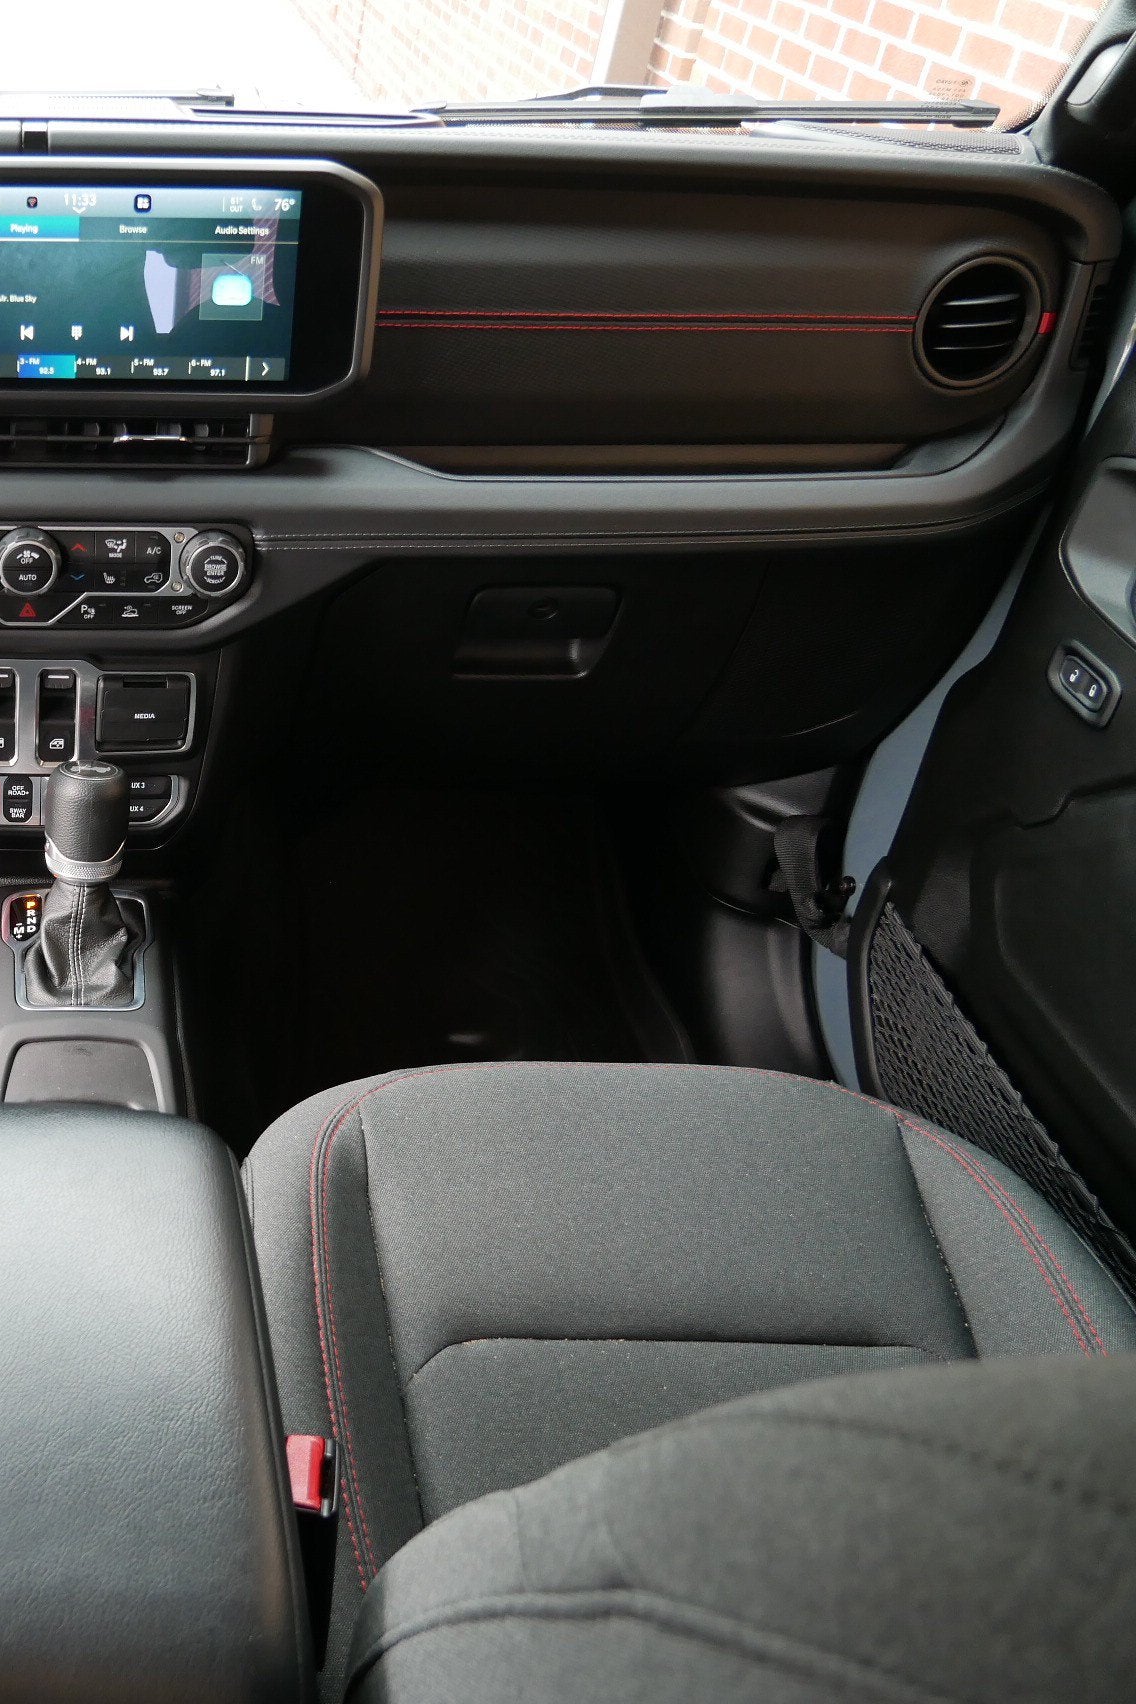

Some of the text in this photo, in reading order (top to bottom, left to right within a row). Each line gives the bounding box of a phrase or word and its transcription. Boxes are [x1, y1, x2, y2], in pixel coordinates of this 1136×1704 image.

[10, 223, 39, 236] Playing
[119, 225, 148, 235] Browse
[214, 225, 270, 237] Audio Settings
[250, 256, 264, 265] FM
[10, 294, 24, 303] Blue
[24, 295, 38, 304] Sky
[146, 546, 161, 555] A/C
[133, 712, 156, 720] MEDIA
[26, 901, 36, 909] P
[13, 926, 25, 934] M
